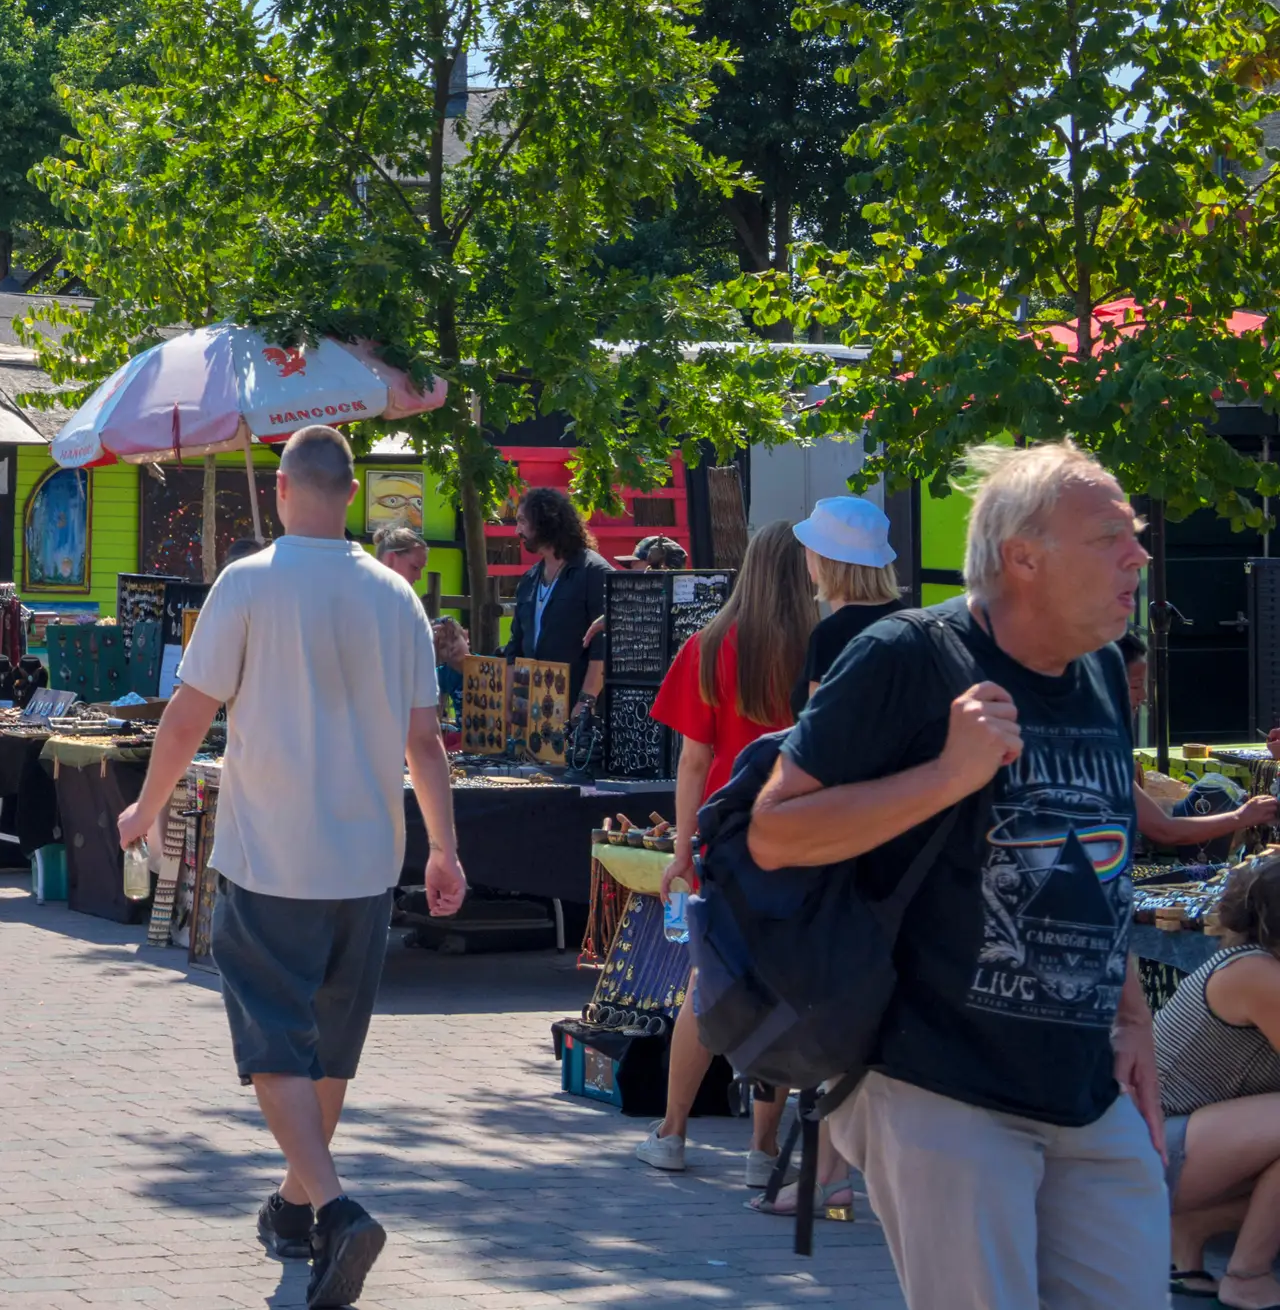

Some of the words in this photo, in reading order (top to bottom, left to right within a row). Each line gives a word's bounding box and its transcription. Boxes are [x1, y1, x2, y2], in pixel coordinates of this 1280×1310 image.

[268, 399, 368, 425] HANCOCK
[1026, 929, 1088, 949] CARNEGIE
[970, 968, 1037, 1002] LIVE
